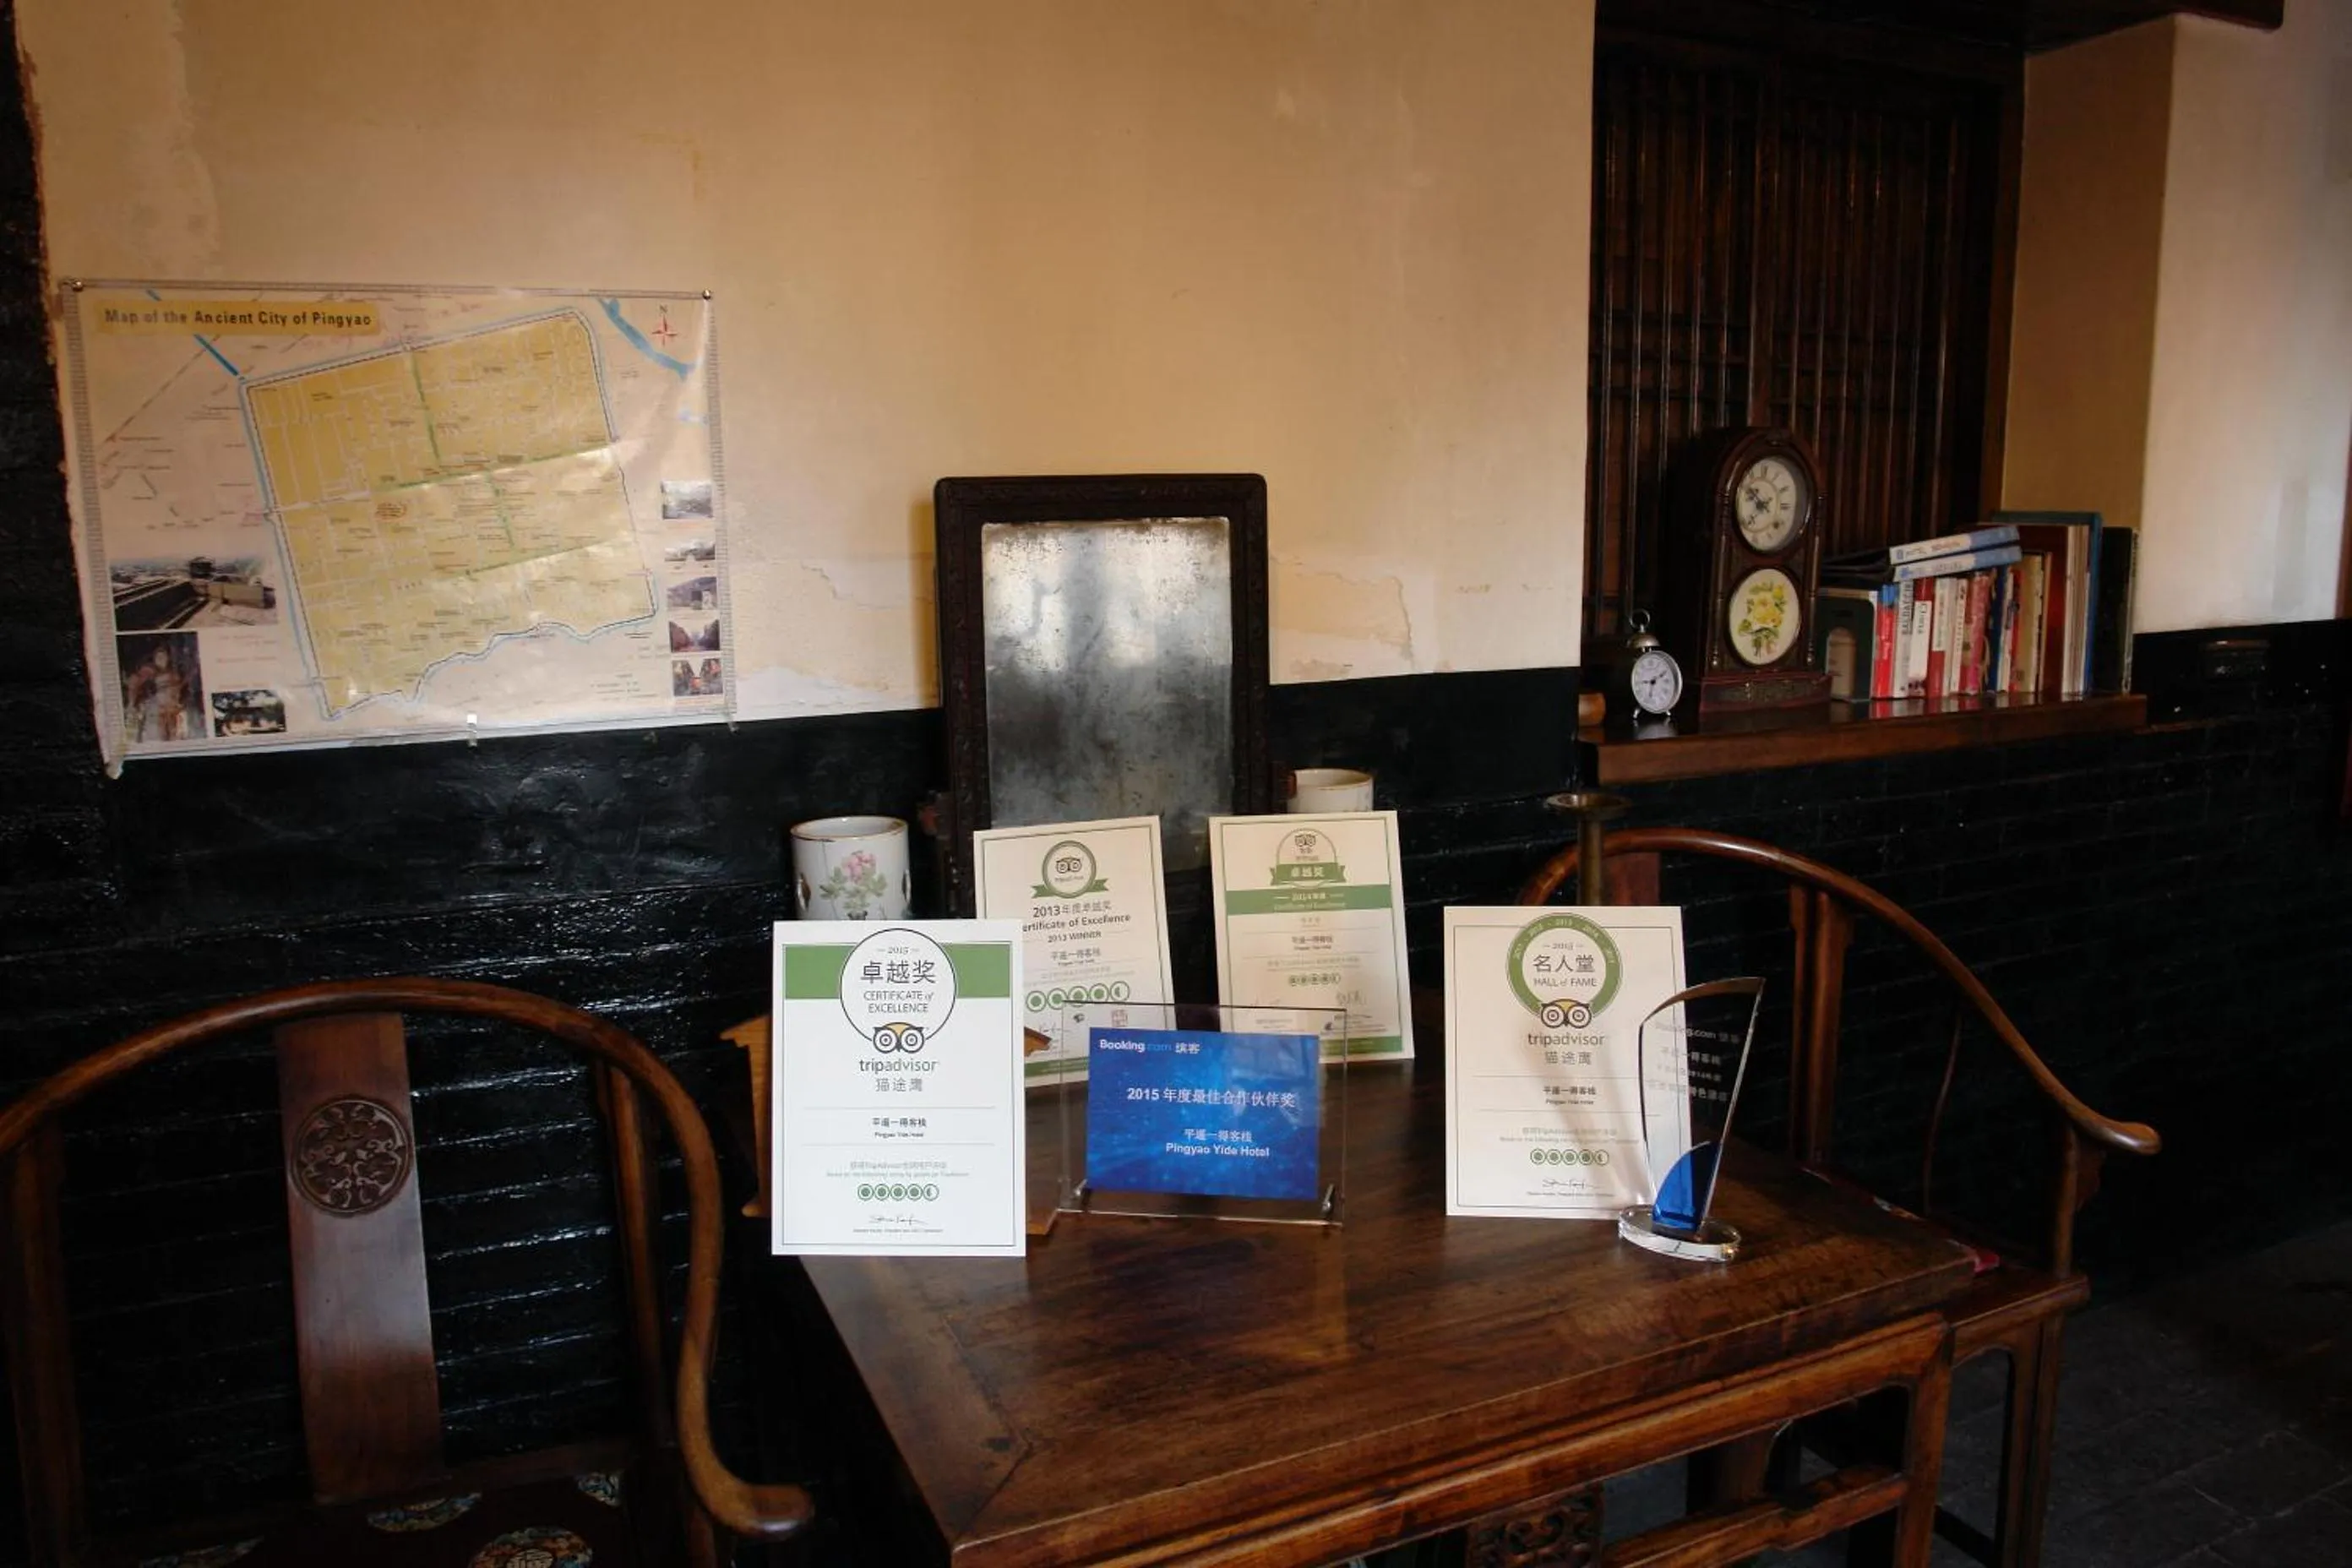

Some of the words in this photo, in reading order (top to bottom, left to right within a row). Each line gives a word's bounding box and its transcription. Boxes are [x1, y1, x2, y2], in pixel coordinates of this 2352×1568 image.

[105, 309, 138, 324] Map
[143, 309, 158, 323] of
[163, 309, 187, 323] the
[194, 310, 253, 324] Ancient
[258, 311, 286, 326] City
[292, 311, 306, 324] of
[313, 312, 372, 328] Pingyao
[1022, 921, 1066, 933] ertificate
[1069, 919, 1079, 928] of
[1081, 913, 1131, 927] Excellence
[1532, 954, 1595, 972] 名人堂
[860, 960, 936, 984] 卓越奖
[1533, 977, 1559, 987] HALL
[1571, 977, 1598, 987] FAME
[863, 989, 923, 1001] CERTIFICATE
[868, 1002, 928, 1014] EXCELLENCE
[1528, 1032, 1605, 1048] tripadvisor
[858, 1058, 939, 1075] tripadvisor
[1162, 1087, 1297, 1108] 年度最佳合作伙伴奖
[1165, 1142, 1211, 1157] Pingyao
[1212, 1145, 1239, 1156] Yide
[1241, 1147, 1271, 1157] Hotel
